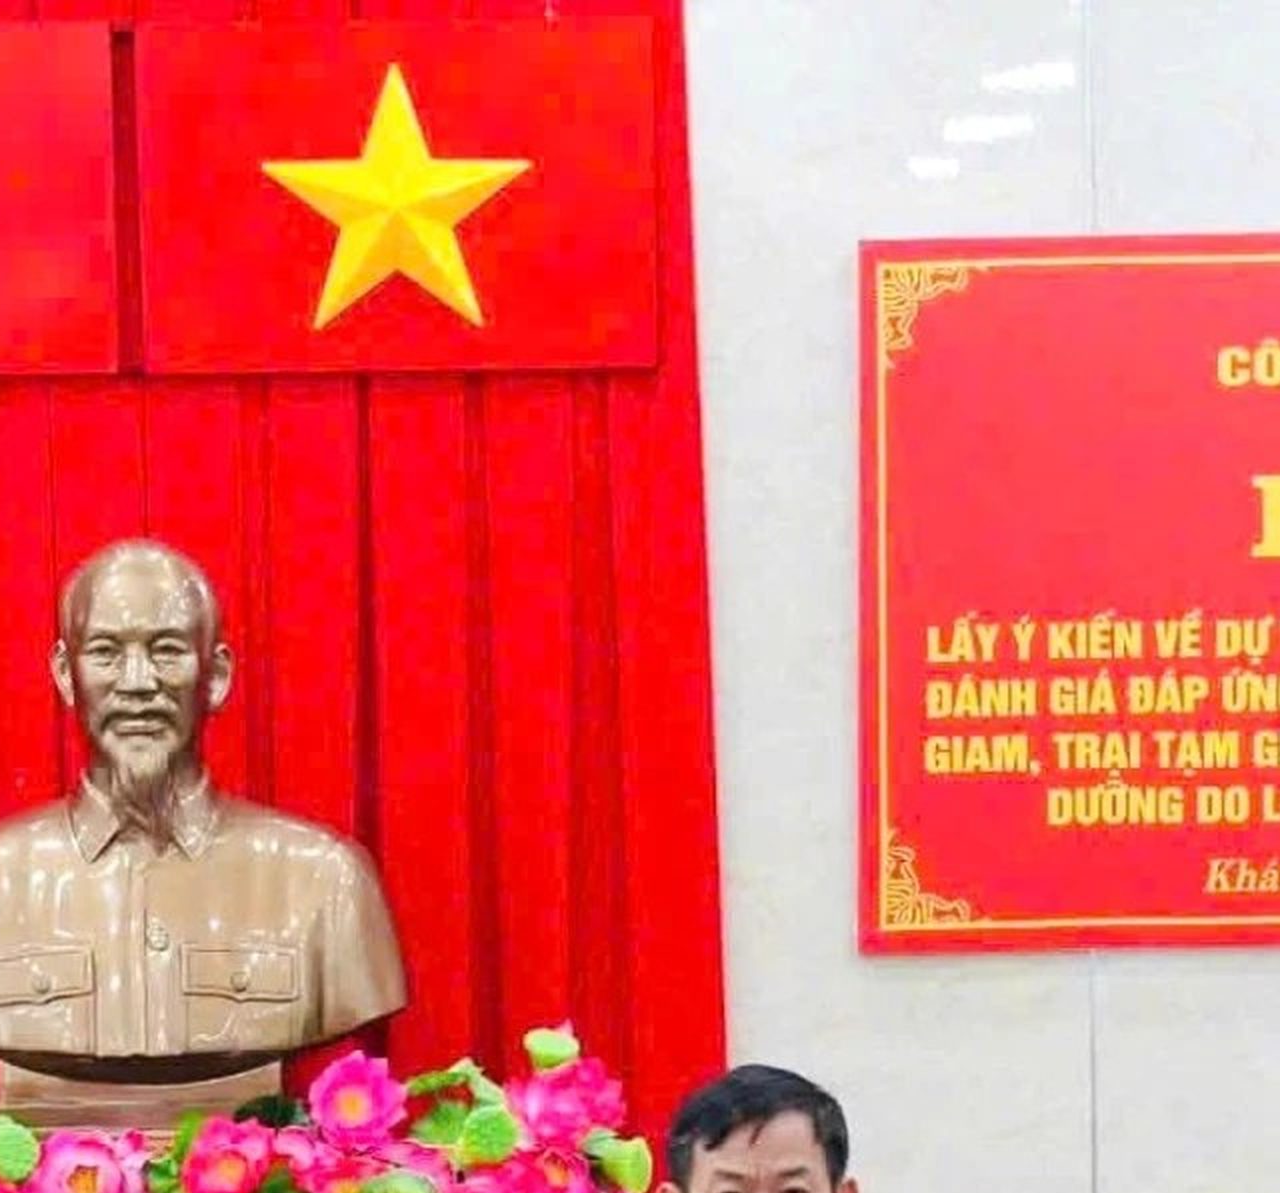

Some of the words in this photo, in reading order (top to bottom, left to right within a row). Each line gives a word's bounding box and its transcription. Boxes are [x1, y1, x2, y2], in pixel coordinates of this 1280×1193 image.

[926, 610, 1000, 663] LẤY
[1013, 613, 1036, 662] Ý
[1047, 608, 1142, 660] KIẾN
[1215, 614, 1274, 665] DỰ
[925, 673, 1037, 719] ĐÁNH
[1050, 667, 1117, 715] GIÁ
[1129, 667, 1209, 714] ĐÁP
[925, 733, 1041, 777] GIAM,
[1052, 731, 1141, 778] TRẠI
[1154, 730, 1240, 778] TẠM
[1047, 777, 1184, 826] DƯỠNG
[1197, 786, 1250, 824] DO
